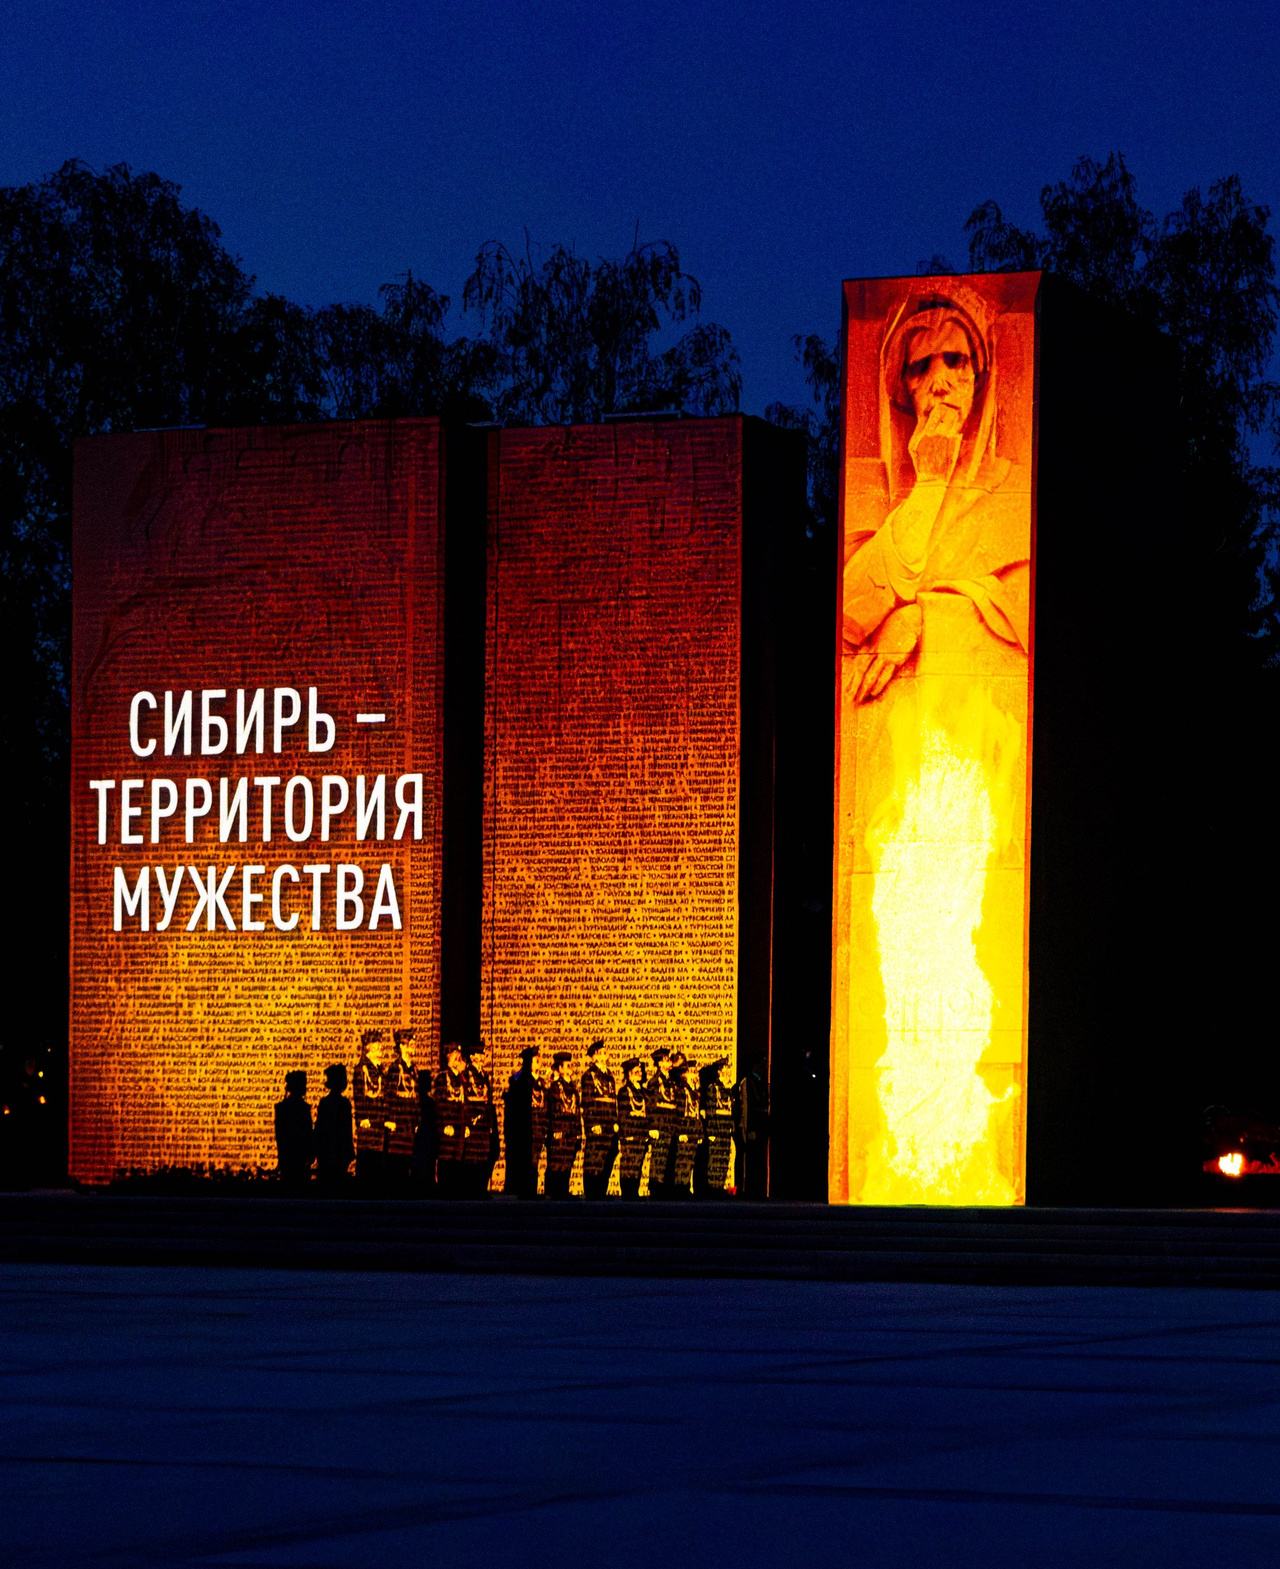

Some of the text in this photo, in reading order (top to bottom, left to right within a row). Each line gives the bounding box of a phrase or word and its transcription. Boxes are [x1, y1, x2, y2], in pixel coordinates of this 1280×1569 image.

[130, 687, 335, 757] СИБИРЬ
[90, 773, 422, 844] ТЕРРИТОРИЯ
[114, 864, 402, 931] МУЖЕСТВА
